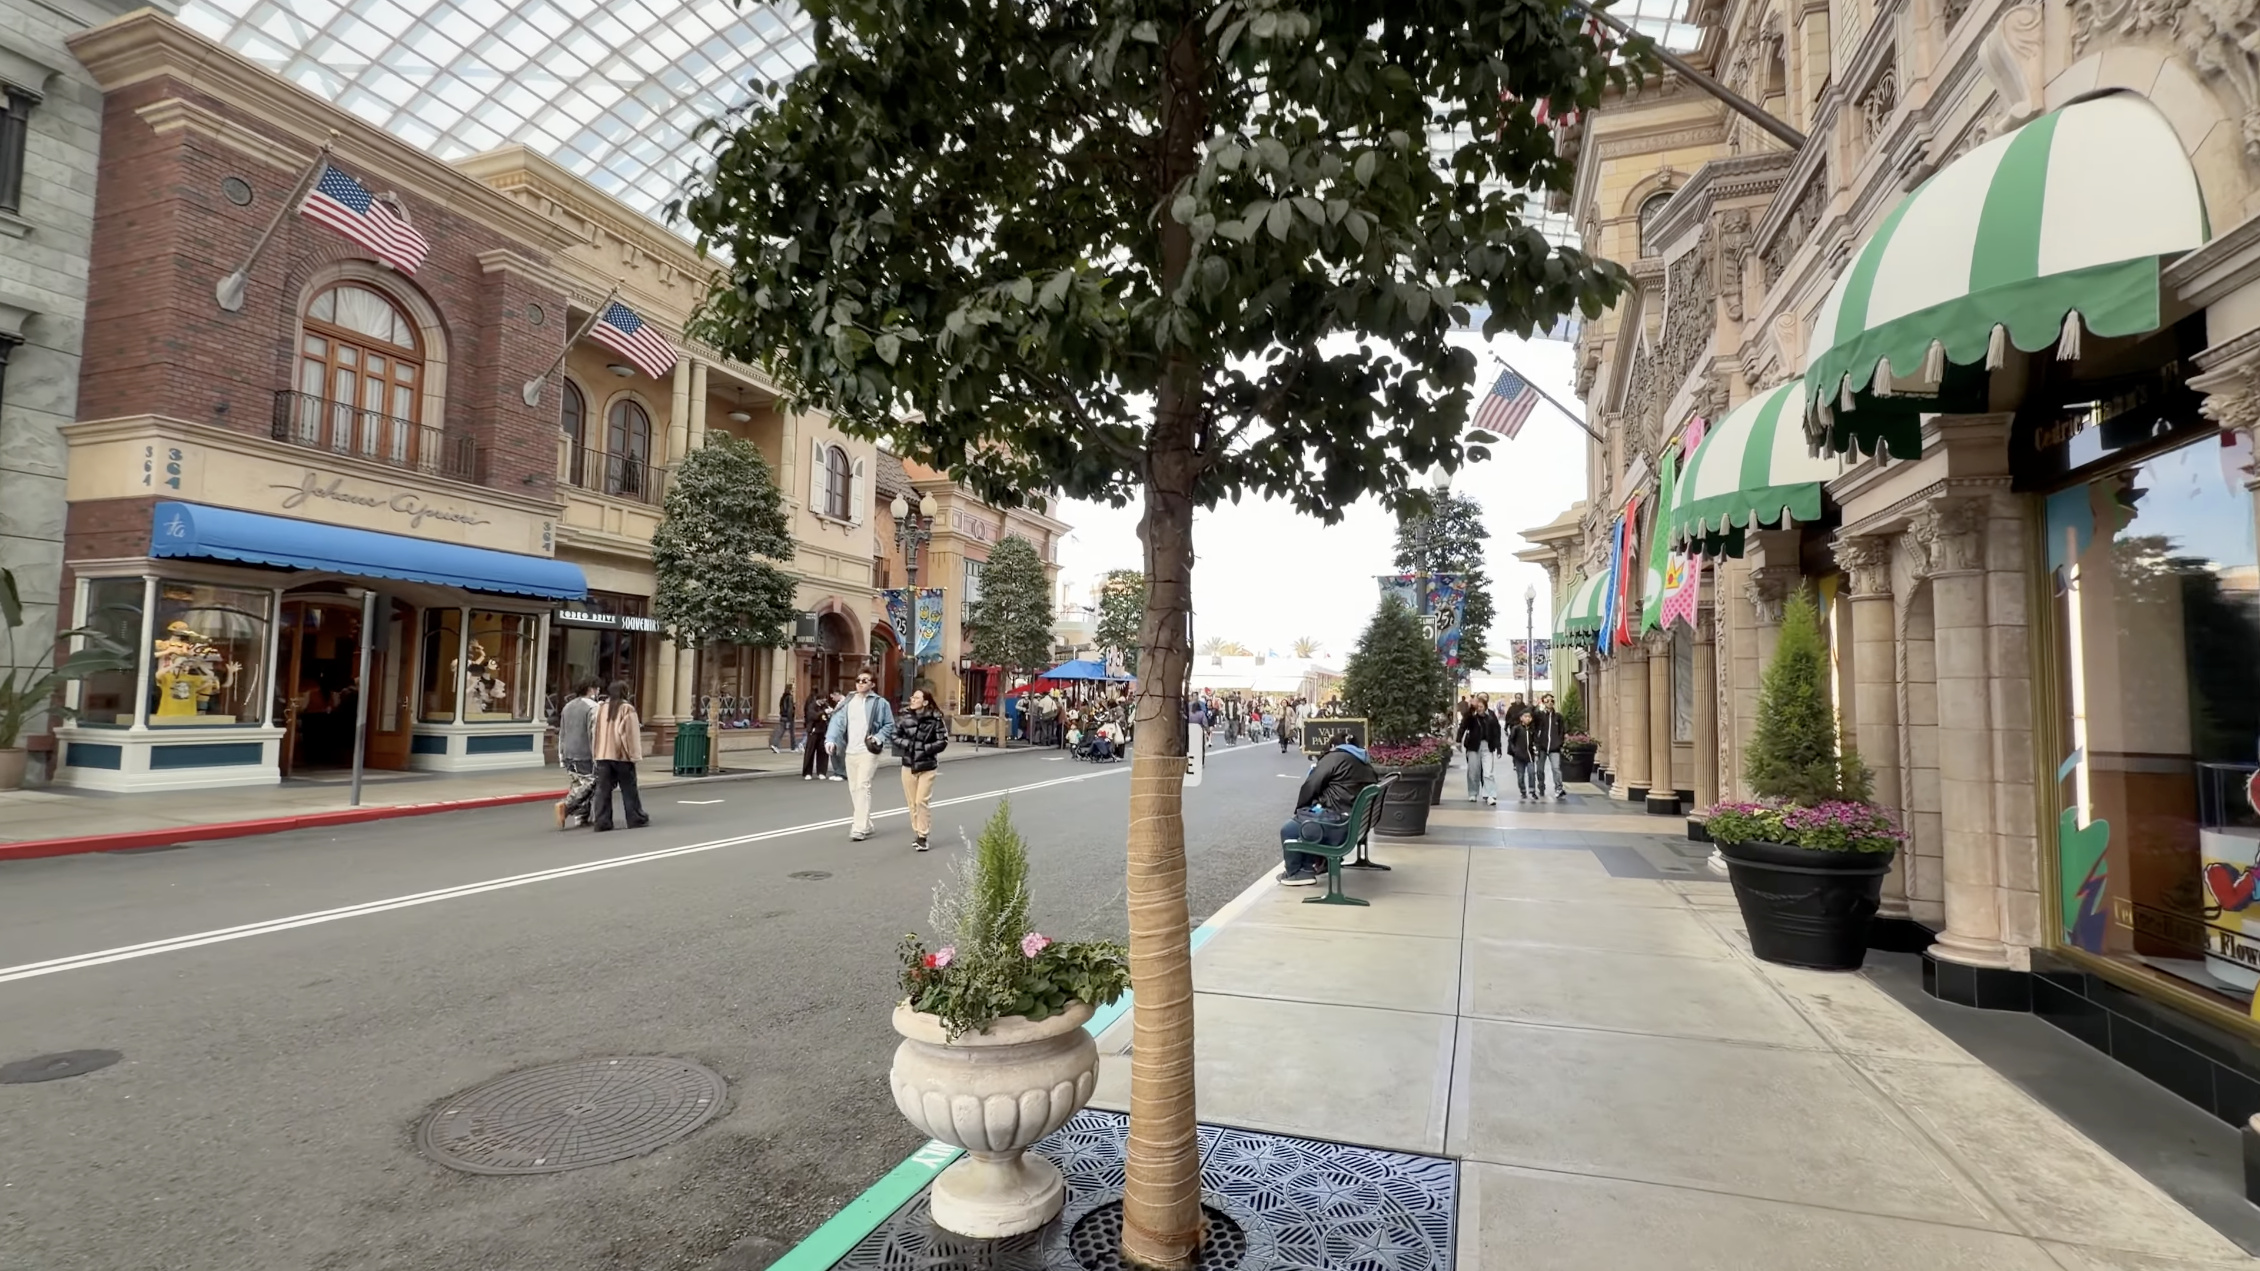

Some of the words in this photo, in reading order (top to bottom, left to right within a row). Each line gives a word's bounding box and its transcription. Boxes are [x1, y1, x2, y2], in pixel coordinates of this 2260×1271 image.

[164, 447, 183, 490] 364
[559, 610, 589, 620] RODEO
[592, 613, 616, 623] DRIVE
[621, 616, 660, 632] SOUVENIRS
